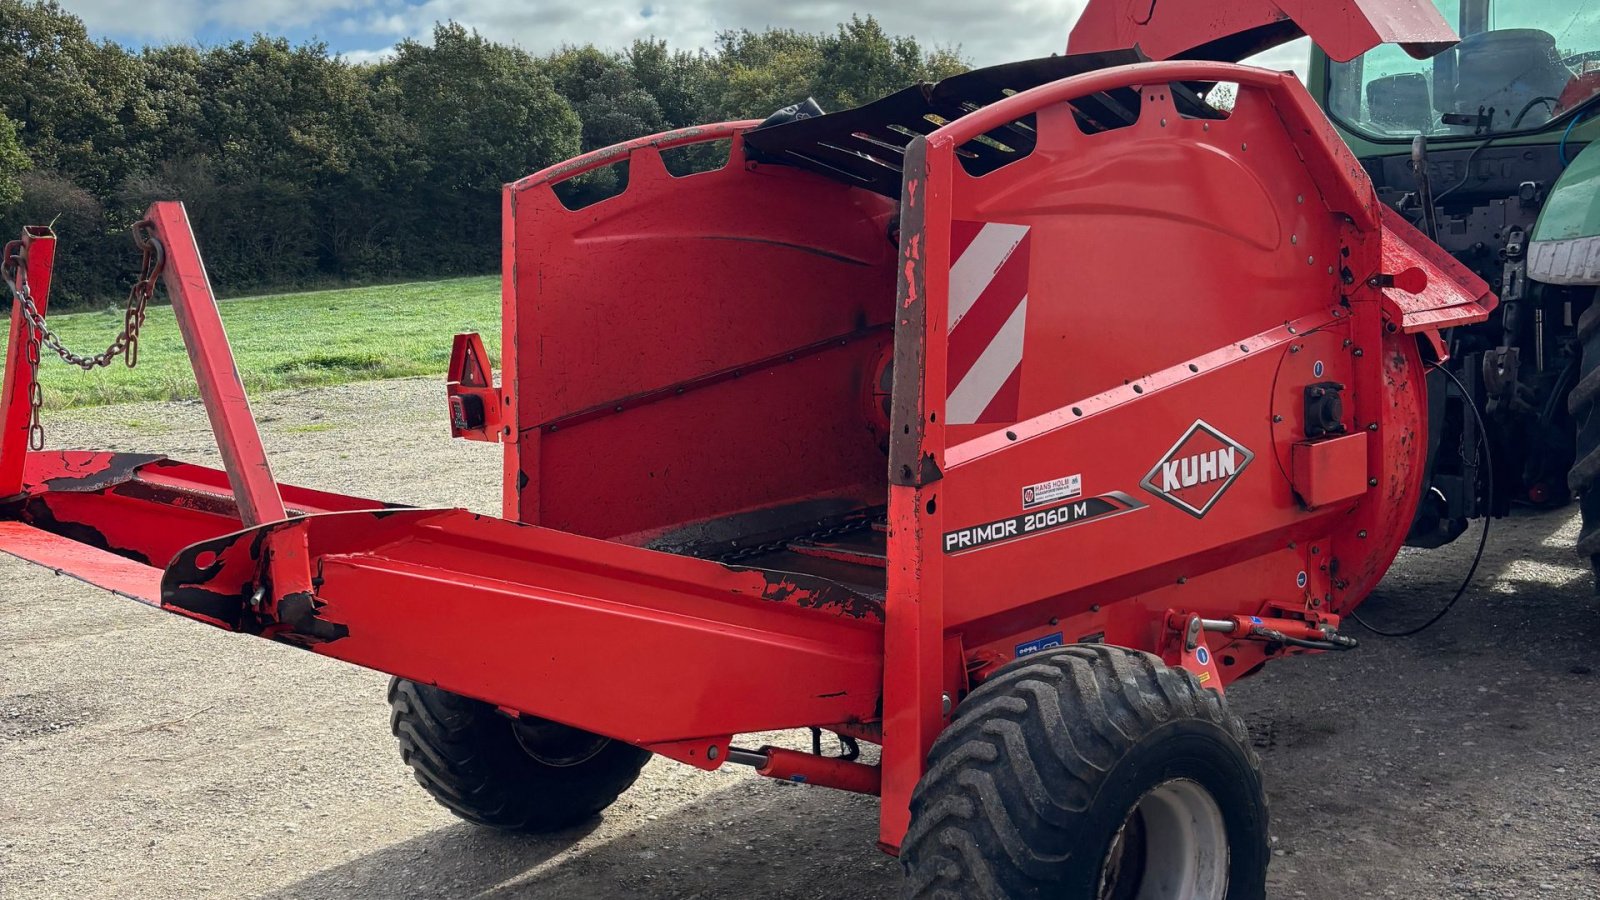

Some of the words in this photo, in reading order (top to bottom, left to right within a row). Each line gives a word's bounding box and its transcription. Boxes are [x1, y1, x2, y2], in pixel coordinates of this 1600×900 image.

[1035, 483, 1052, 492] HANS
[1162, 446, 1235, 493] KUHN
[946, 519, 1018, 551] PRIMOR
[1024, 506, 1068, 532] 2060
[1073, 501, 1087, 519] M
